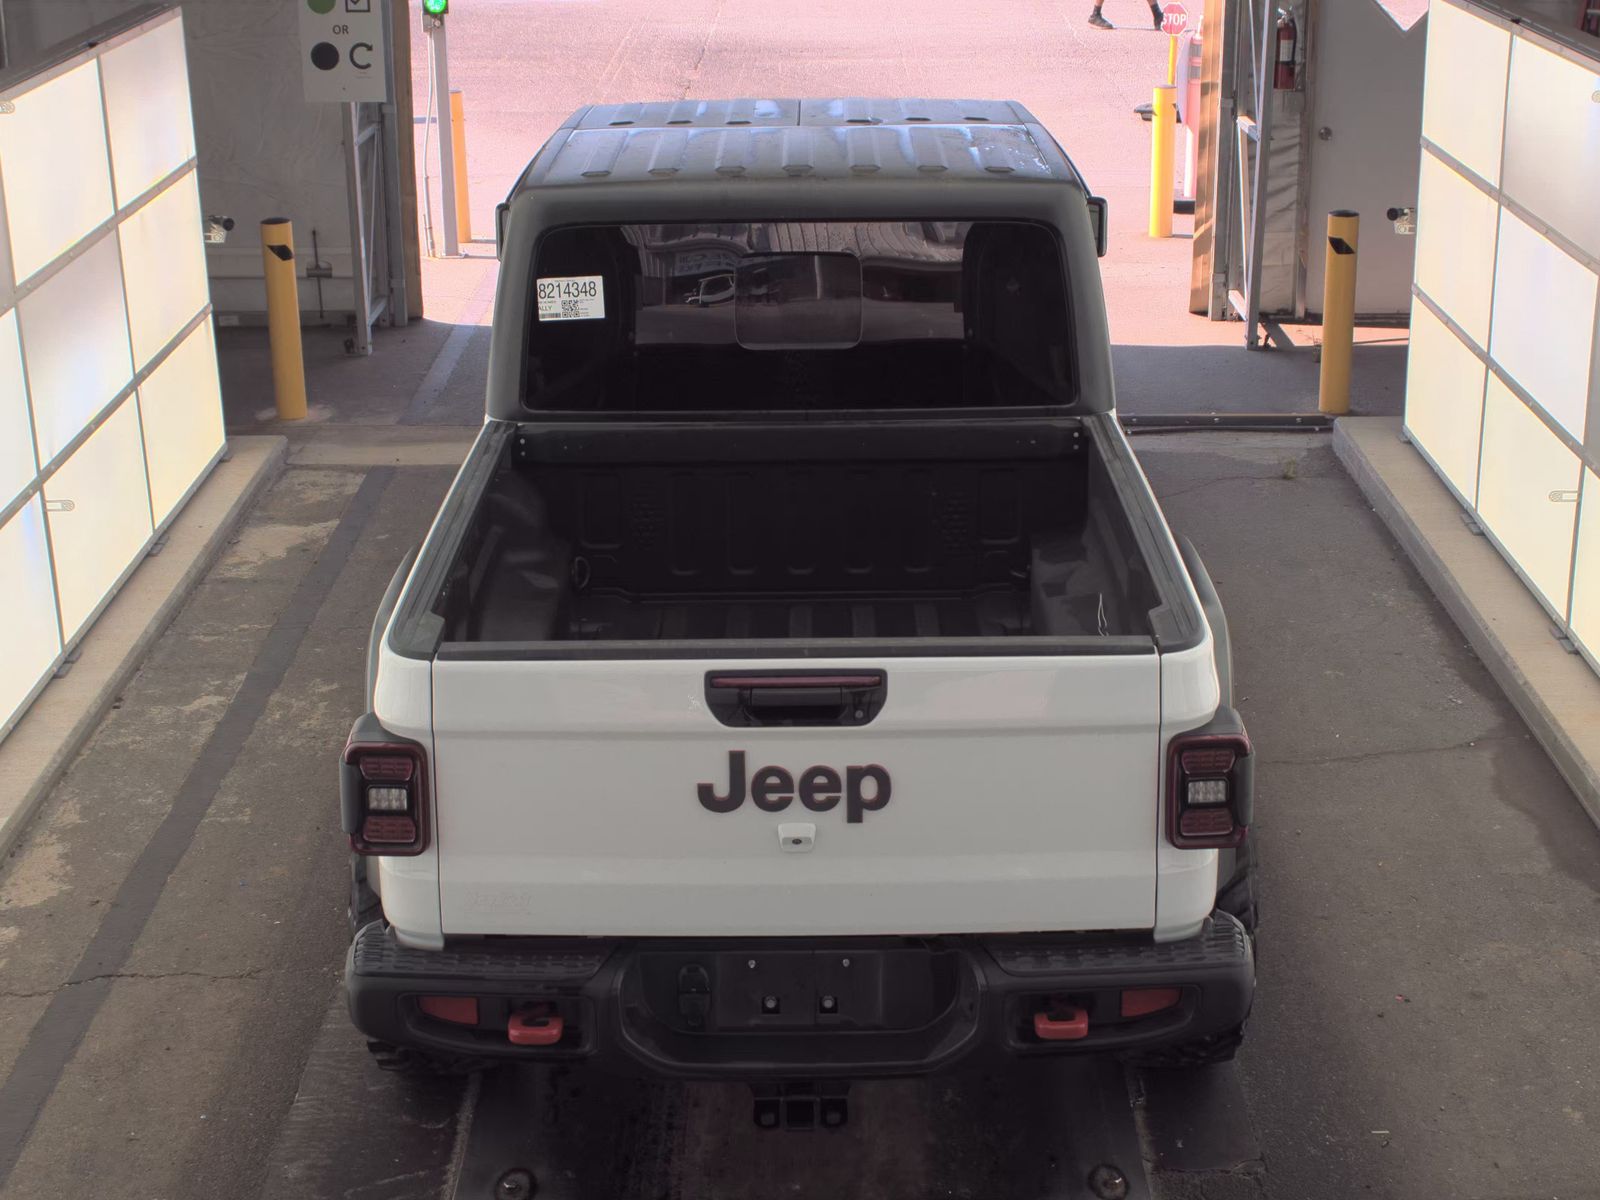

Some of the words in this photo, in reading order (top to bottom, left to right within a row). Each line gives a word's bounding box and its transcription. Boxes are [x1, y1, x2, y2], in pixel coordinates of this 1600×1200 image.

[1163, 13, 1186, 25] STOP
[332, 24, 349, 35] OR
[538, 281, 597, 299] 8214348
[697, 750, 892, 824] Jeep
